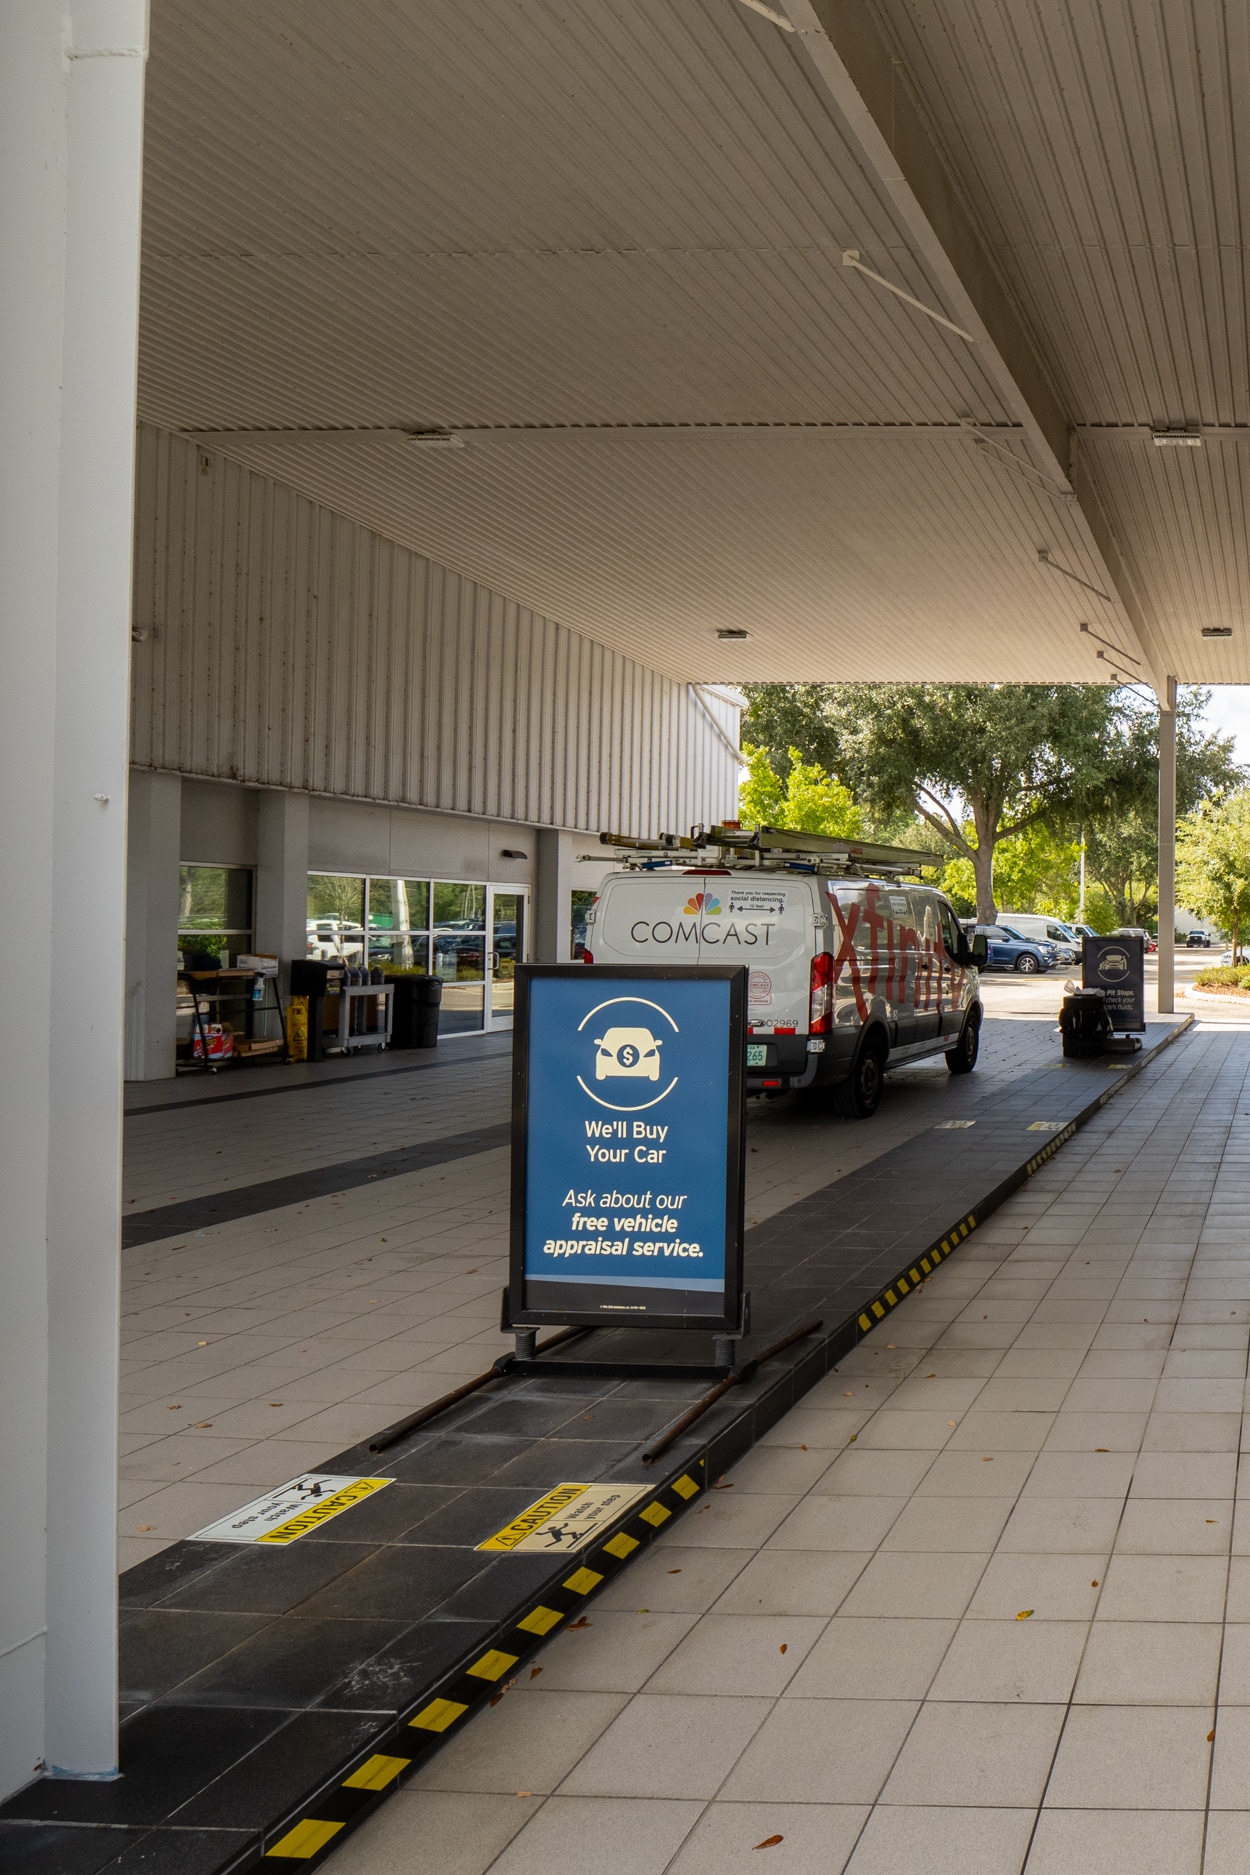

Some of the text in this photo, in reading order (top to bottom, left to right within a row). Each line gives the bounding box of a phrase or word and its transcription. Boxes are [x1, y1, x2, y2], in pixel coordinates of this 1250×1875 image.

[631, 921, 776, 946] COMCAST
[766, 1019, 799, 1027] 02969
[585, 1120, 669, 1142] We'll Buy
[586, 1145, 667, 1163] Your Car
[562, 1189, 687, 1209] Ask about our
[571, 1212, 678, 1232] free vehicle
[543, 1236, 704, 1258] appraisal service.
[232, 1501, 284, 1529] your step
[264, 1503, 303, 1522] Watch
[269, 1494, 358, 1538] CAUTION
[511, 1487, 582, 1531] CAUTION
[564, 1501, 594, 1520] Watch
[584, 1494, 622, 1520] your step
